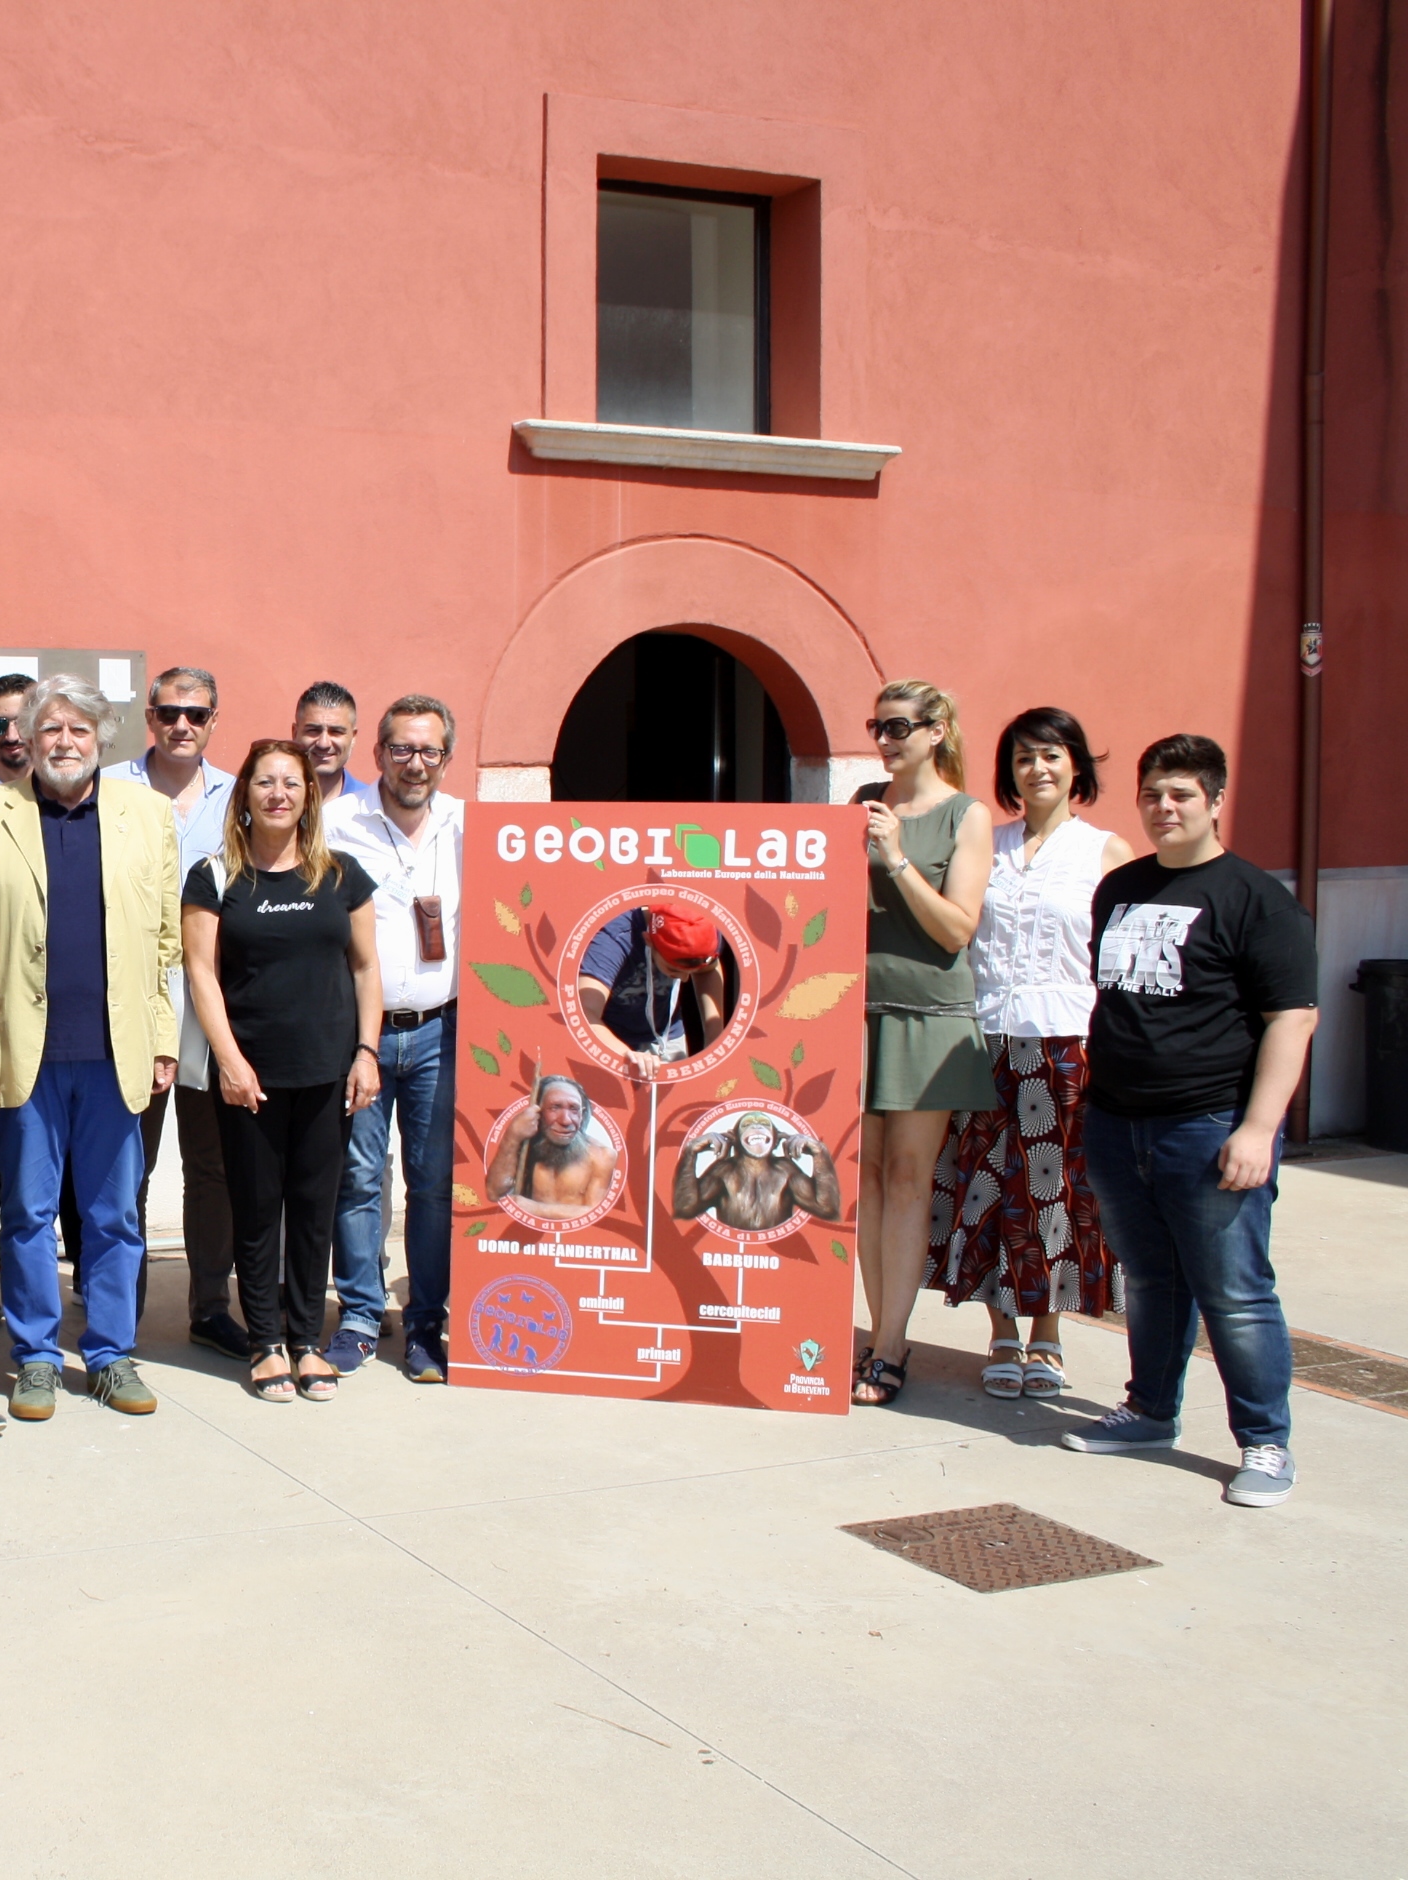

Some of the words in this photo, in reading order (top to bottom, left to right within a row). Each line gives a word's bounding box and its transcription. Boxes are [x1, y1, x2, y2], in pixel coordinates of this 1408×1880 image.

[661, 869, 713, 878] Laboratorio
[714, 870, 752, 880] Europeo
[754, 870, 777, 880] della
[779, 870, 826, 881] Naturalità
[257, 900, 314, 913] dreamer
[566, 897, 620, 960] Laboratorio
[621, 888, 675, 901] Europeo
[678, 889, 710, 910] della
[710, 905, 754, 968] Naturalità
[1117, 982, 1140, 993] THE
[564, 984, 630, 1074] PROVINCIA
[667, 993, 752, 1079] BENEVENTO
[491, 1100, 530, 1144] Laboratorio
[688, 1107, 724, 1142] boratorio
[724, 1101, 765, 1111] Europeo
[766, 1103, 790, 1117] della
[501, 1199, 536, 1227] INCIA
[542, 1222, 555, 1230] di
[561, 1169, 622, 1230] BENEVENTO
[757, 1210, 809, 1240] BENEVE
[478, 1239, 520, 1254] UOMO
[523, 1244, 536, 1255] di
[538, 1243, 638, 1261] NEANDERTHAL
[702, 1252, 780, 1270] BABBUINO
[579, 1296, 625, 1311] ominidi
[699, 1304, 781, 1321] cercopitecidi
[637, 1347, 681, 1362] primati
